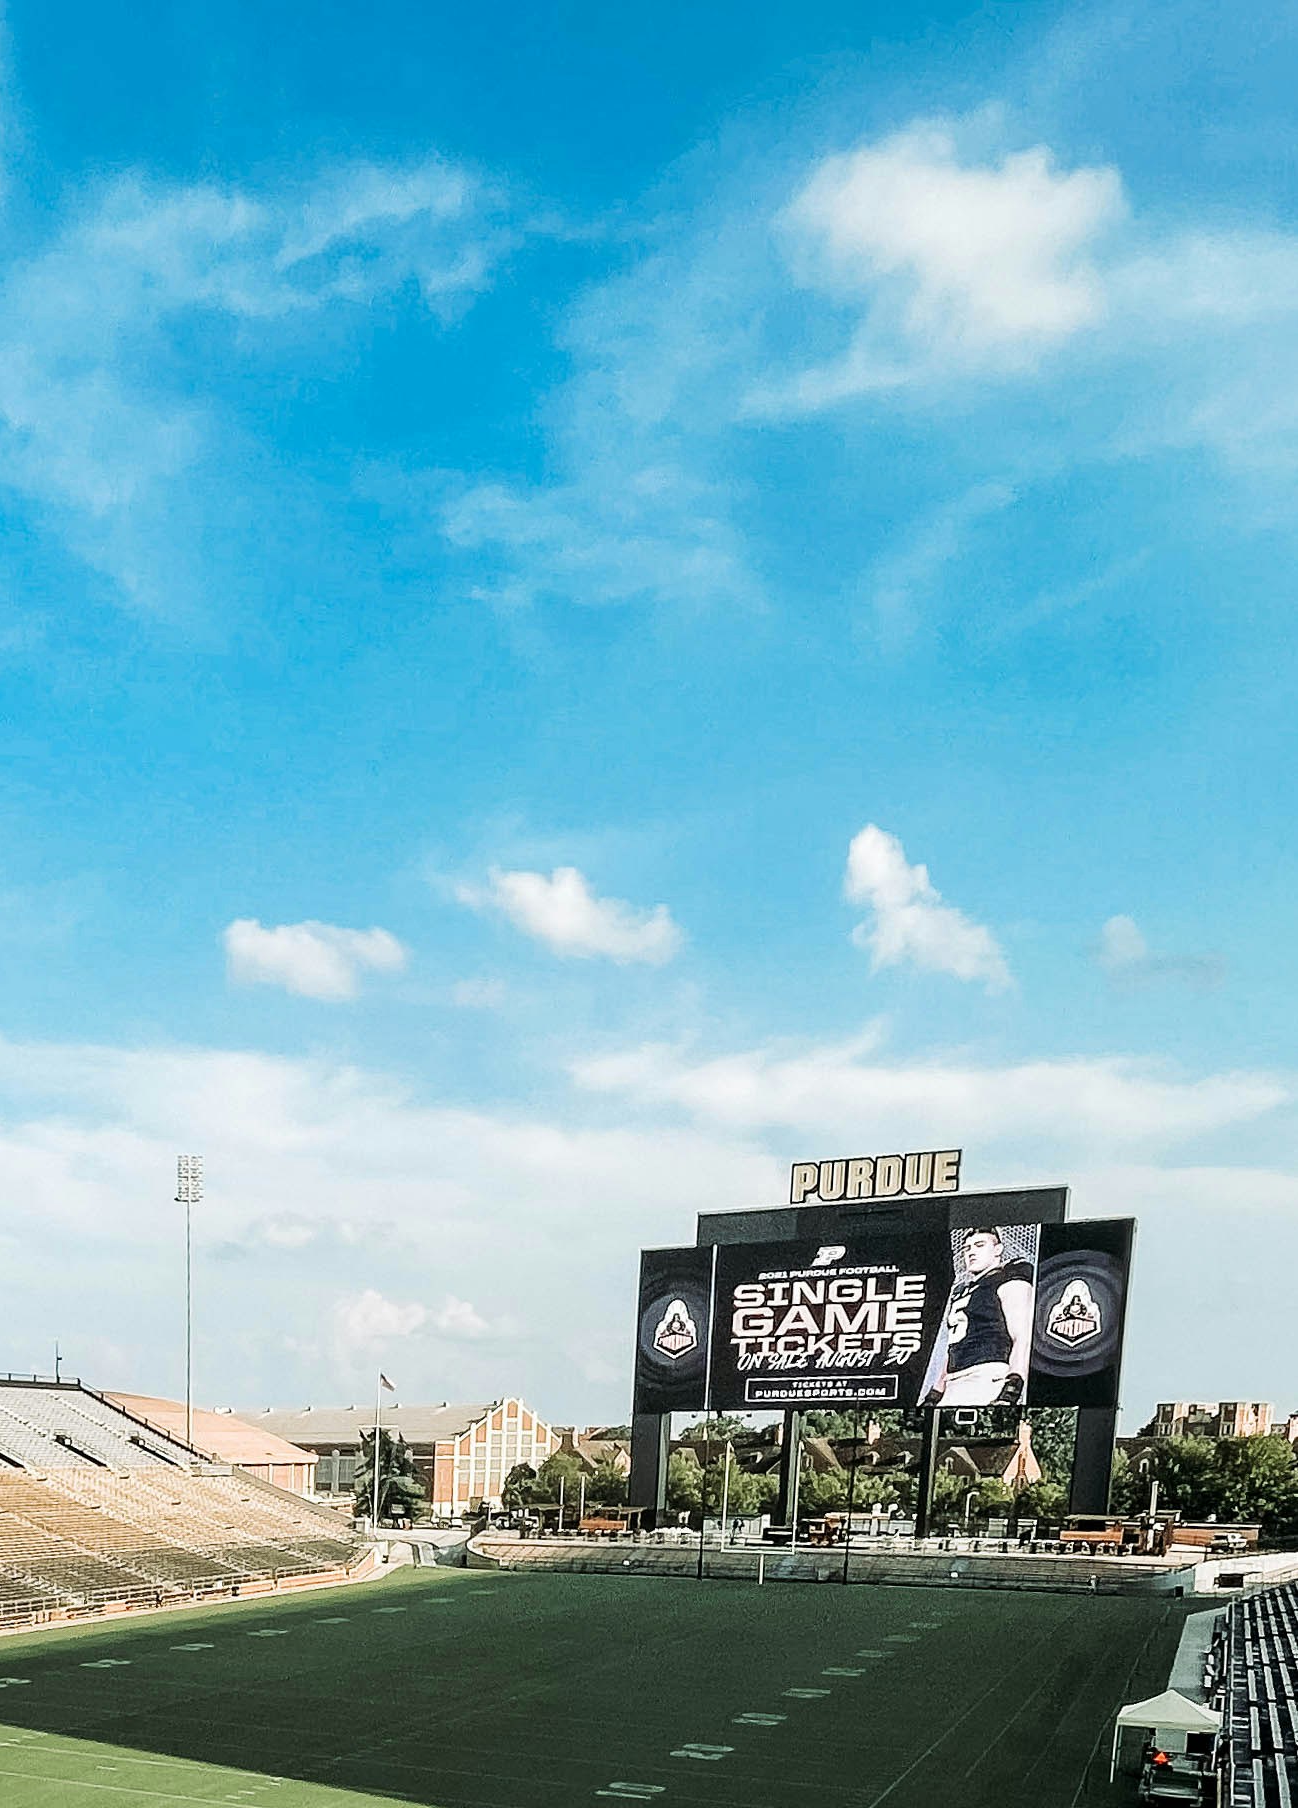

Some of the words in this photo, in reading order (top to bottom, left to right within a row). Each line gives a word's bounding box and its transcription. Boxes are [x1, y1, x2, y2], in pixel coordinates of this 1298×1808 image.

[791, 1150, 961, 1204] PURDUE
[810, 1245, 846, 1267] P
[758, 1271, 788, 1280] 2021
[789, 1269, 837, 1278] PURDUE
[838, 1265, 900, 1275] FOOTBALL
[733, 1275, 926, 1307] SINGLE
[732, 1300, 925, 1337] GAME
[730, 1332, 922, 1357] TICKETS
[737, 1351, 763, 1371] ON
[767, 1352, 808, 1370] SALE
[815, 1349, 875, 1369] AUGUST
[882, 1346, 913, 1367] 30
[755, 1388, 886, 1398] PURDUESPORTS.COM
[792, 1381, 833, 1389] TICKETS
